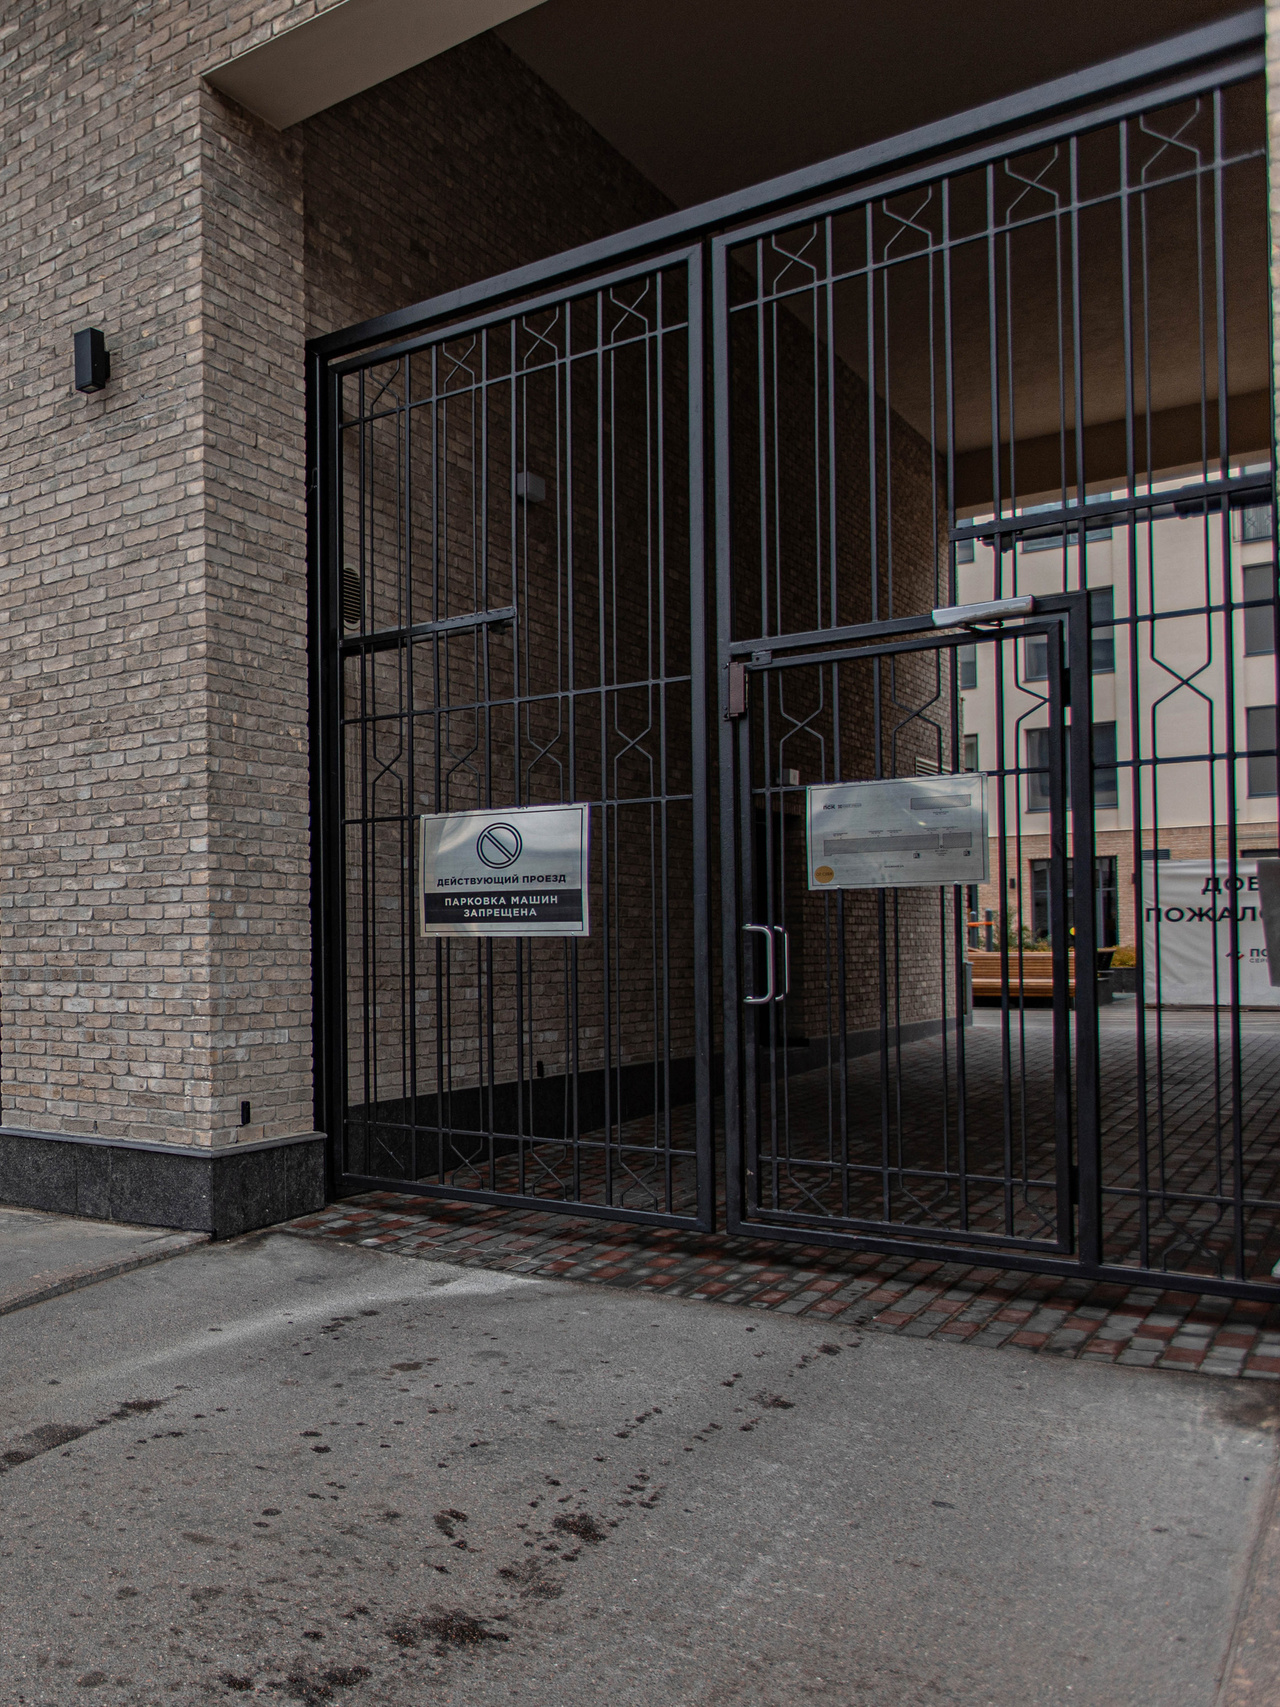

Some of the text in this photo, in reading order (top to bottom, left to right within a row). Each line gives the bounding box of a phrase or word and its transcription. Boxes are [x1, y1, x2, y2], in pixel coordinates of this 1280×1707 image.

[436, 874, 566, 887] ДЕЙСТВУЮЩИЙ ПРОЕЗД
[444, 895, 558, 906] ПАРКОВКА МАШИН
[463, 908, 538, 918] ЗАПРЕЩЕНА
[1145, 906, 1263, 923] ПОЖАЛ
